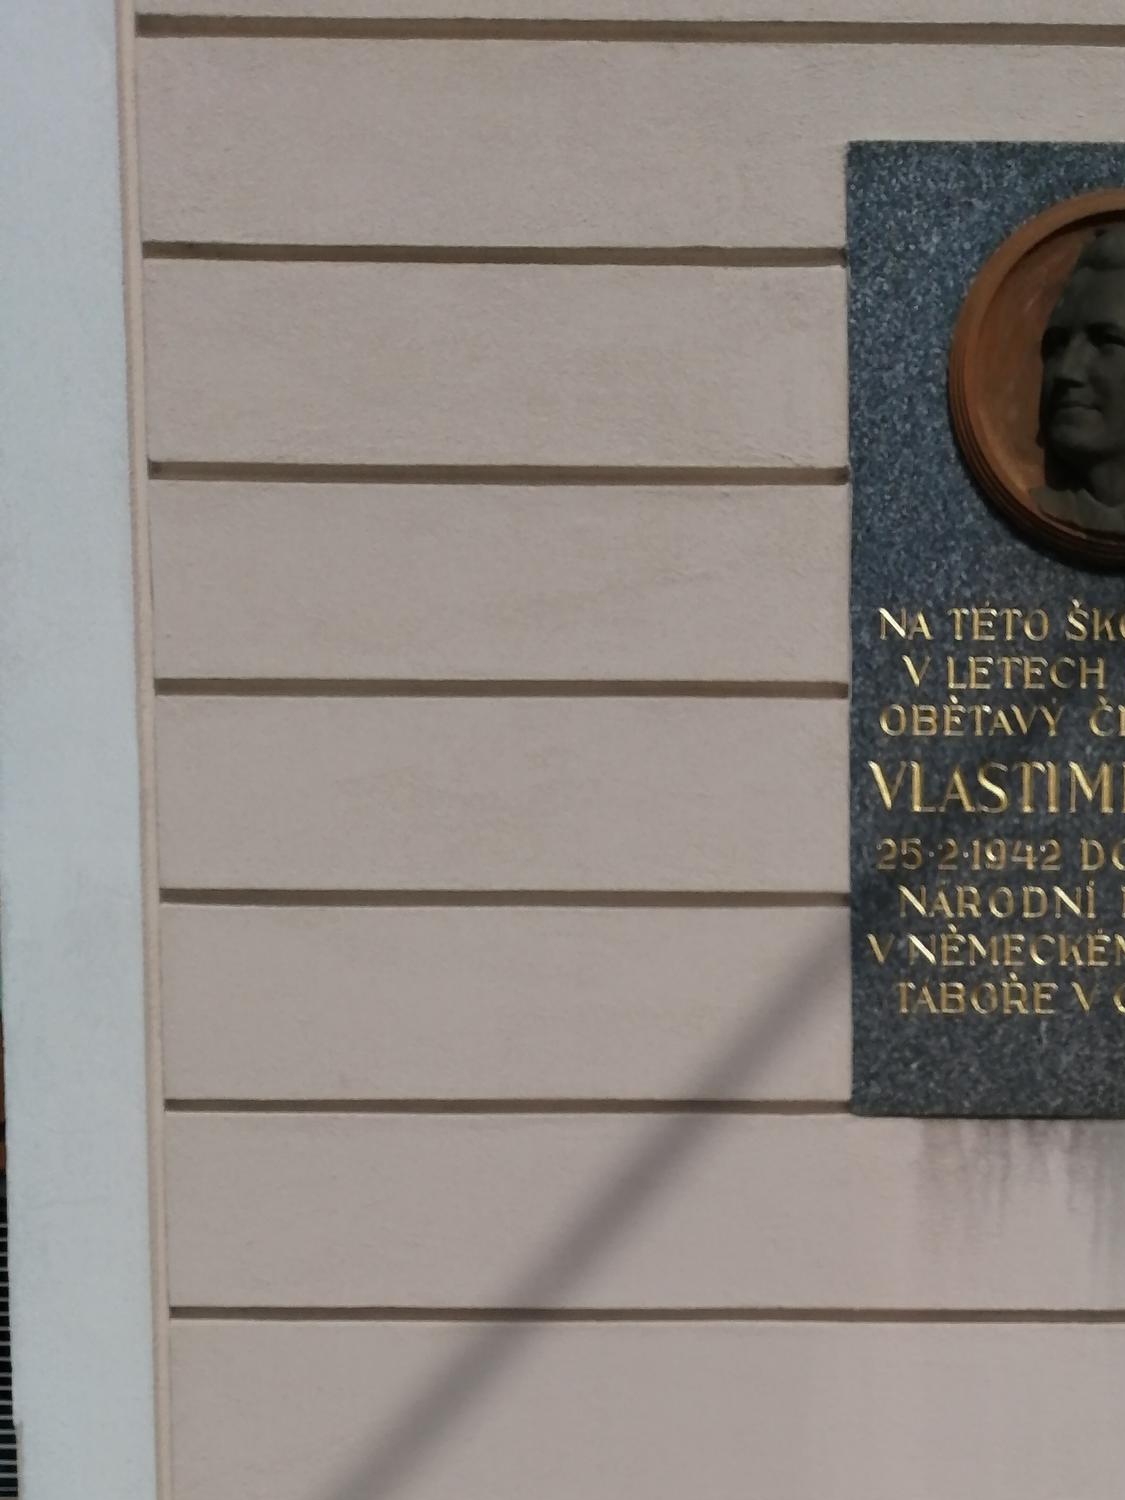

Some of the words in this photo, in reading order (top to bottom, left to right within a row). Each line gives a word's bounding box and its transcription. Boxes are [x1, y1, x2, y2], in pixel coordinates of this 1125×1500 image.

[879, 608, 933, 640] NA
[902, 655, 931, 687] V
[946, 656, 1105, 689] LETECH
[867, 933, 894, 965] V
[1072, 981, 1095, 1014] V
